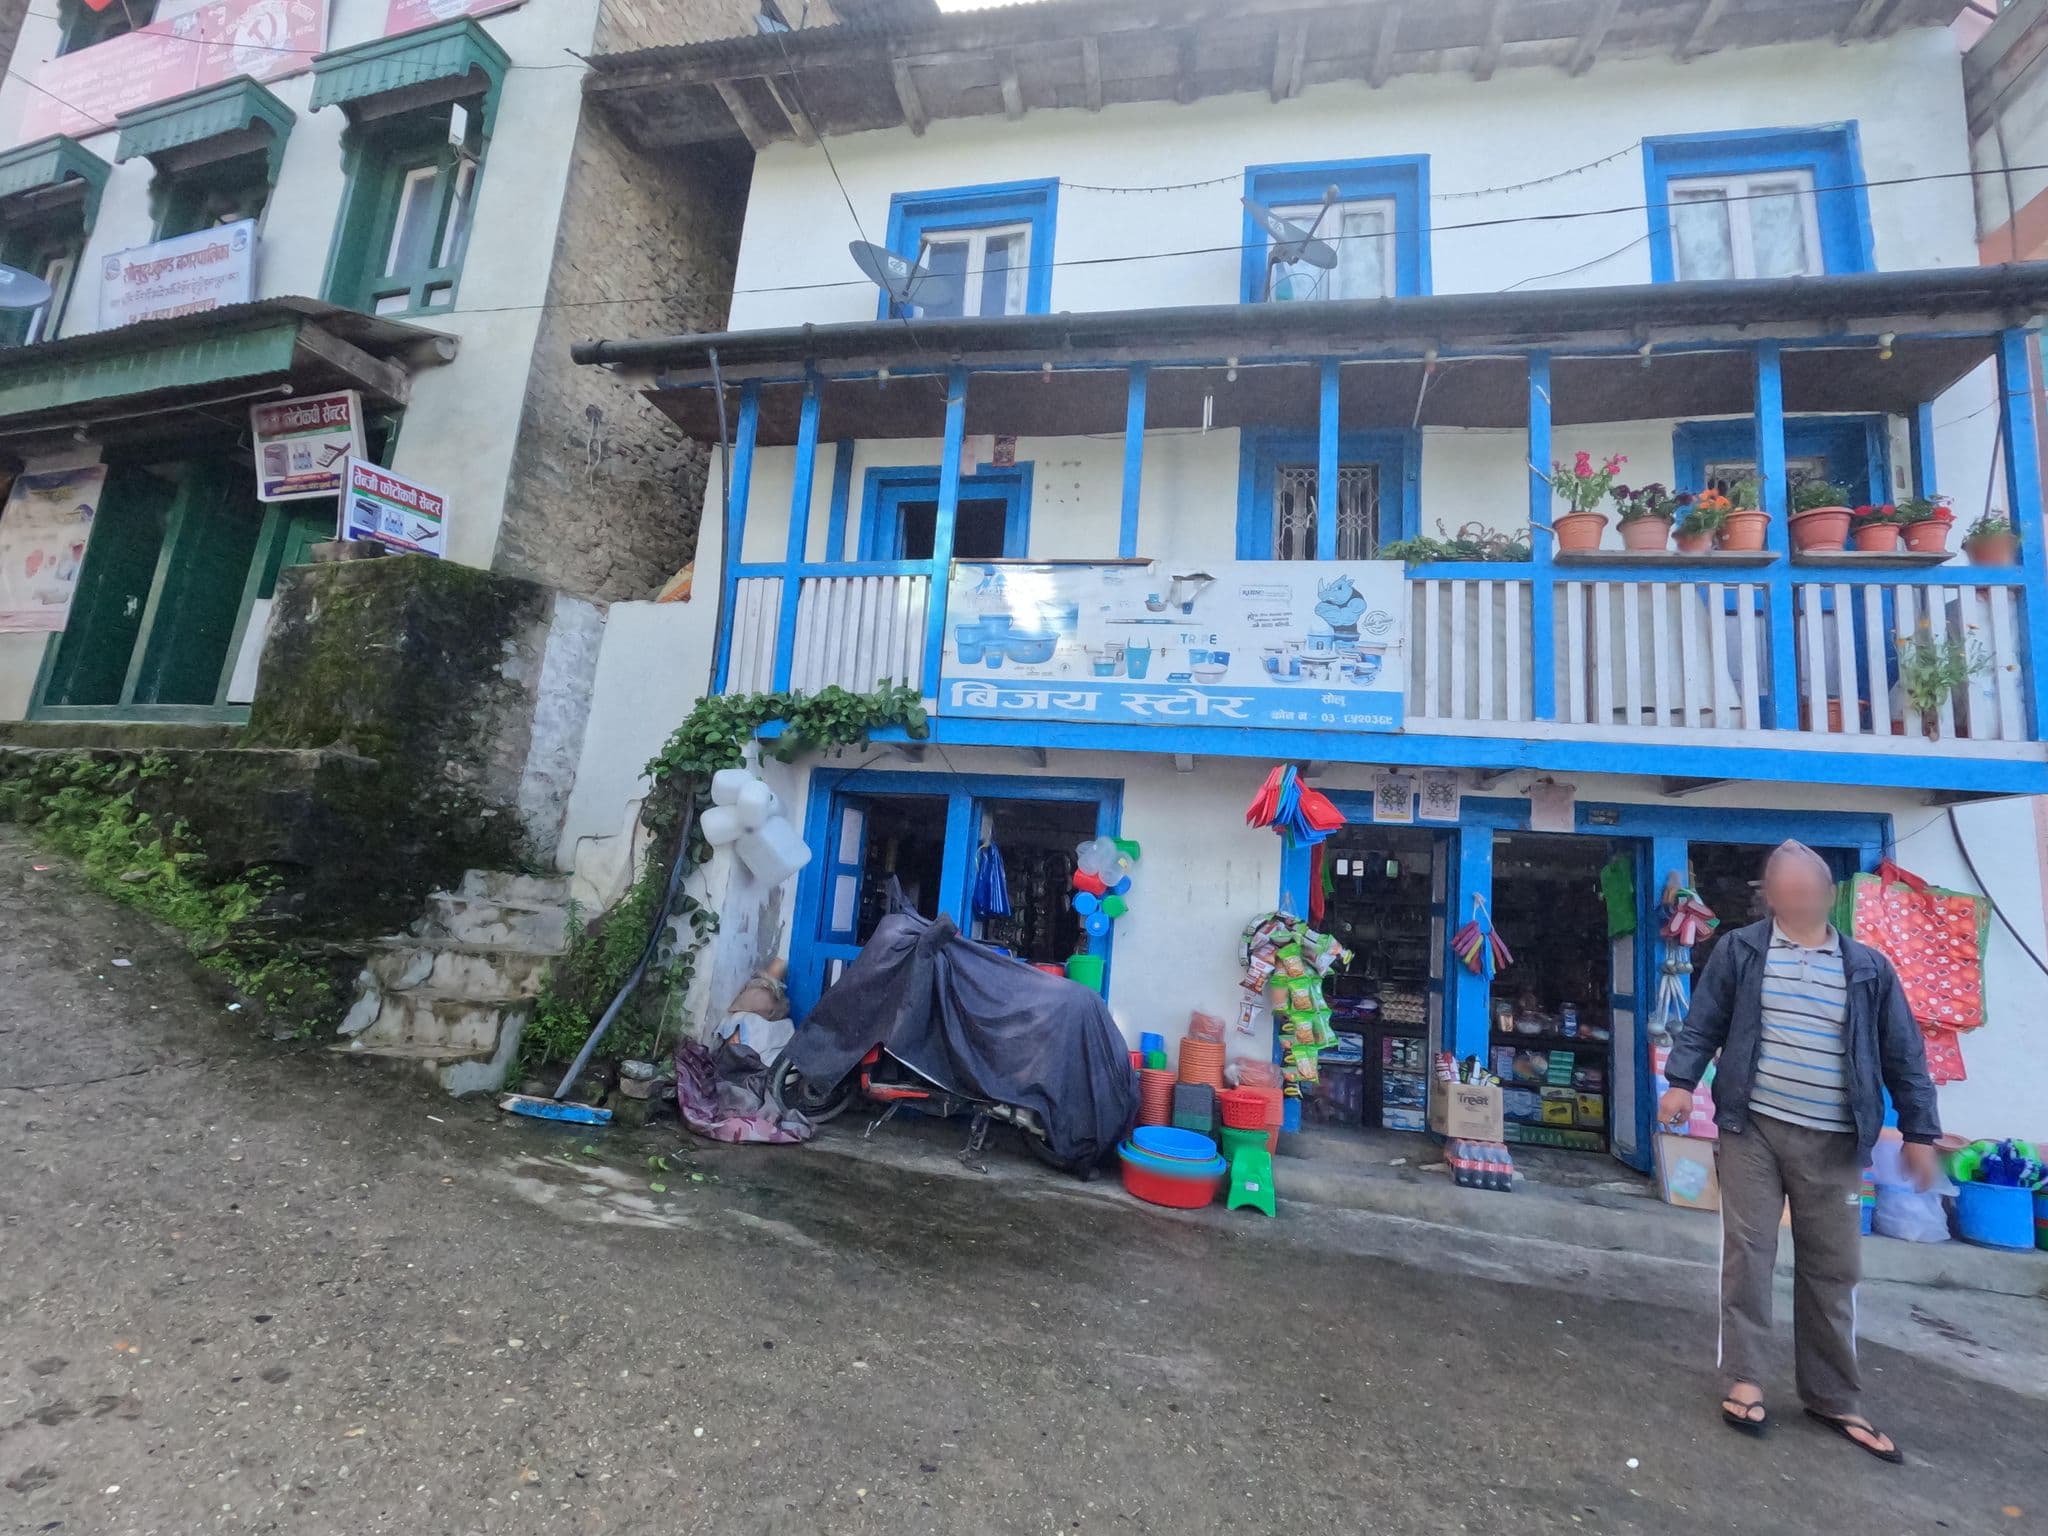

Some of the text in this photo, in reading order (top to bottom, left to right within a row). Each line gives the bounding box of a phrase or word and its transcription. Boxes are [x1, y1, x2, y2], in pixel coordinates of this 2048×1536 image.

[379, 480, 418, 506] फोटोकपी
[418, 493, 442, 516] सेन्टर
[951, 681, 1257, 720] बिजय स्टोर
[1456, 1092, 1490, 1106] Treat
